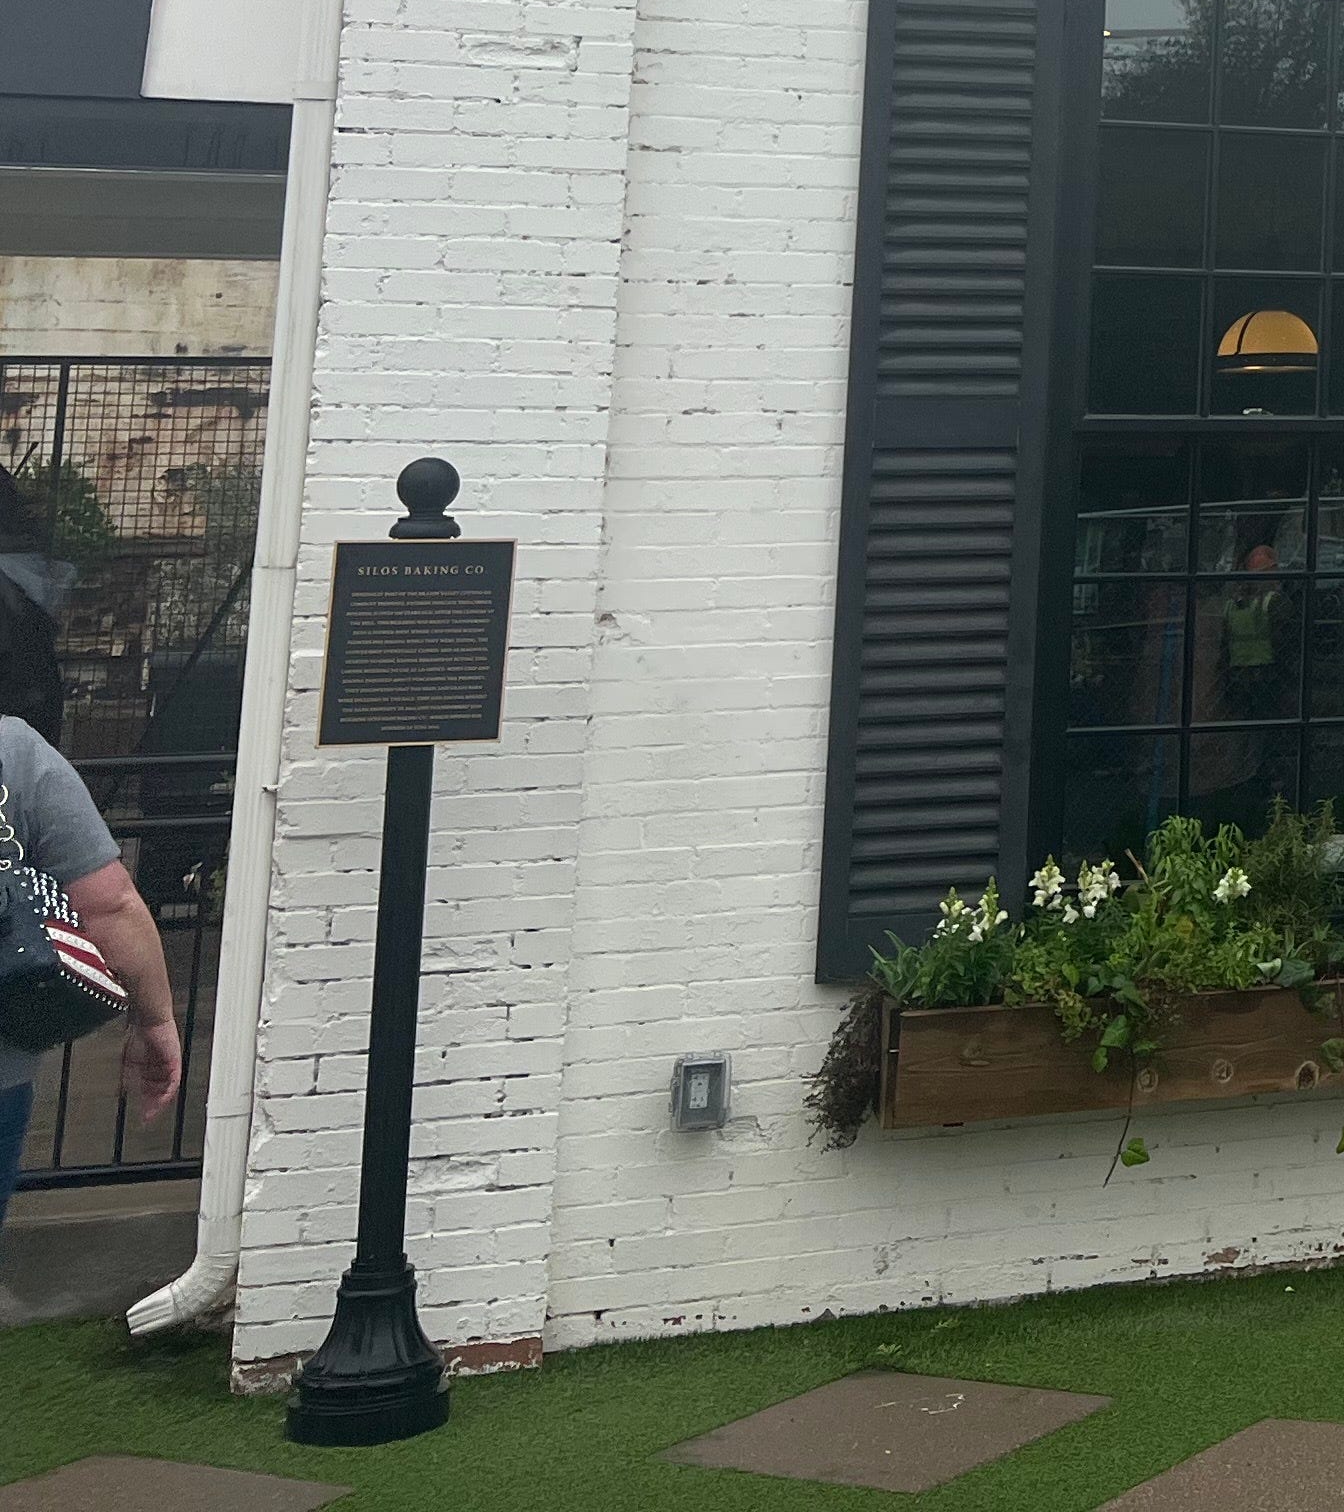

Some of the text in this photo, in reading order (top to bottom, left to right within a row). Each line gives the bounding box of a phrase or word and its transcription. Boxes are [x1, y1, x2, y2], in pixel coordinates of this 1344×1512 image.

[357, 565, 484, 576] SILOS BAKING CO
